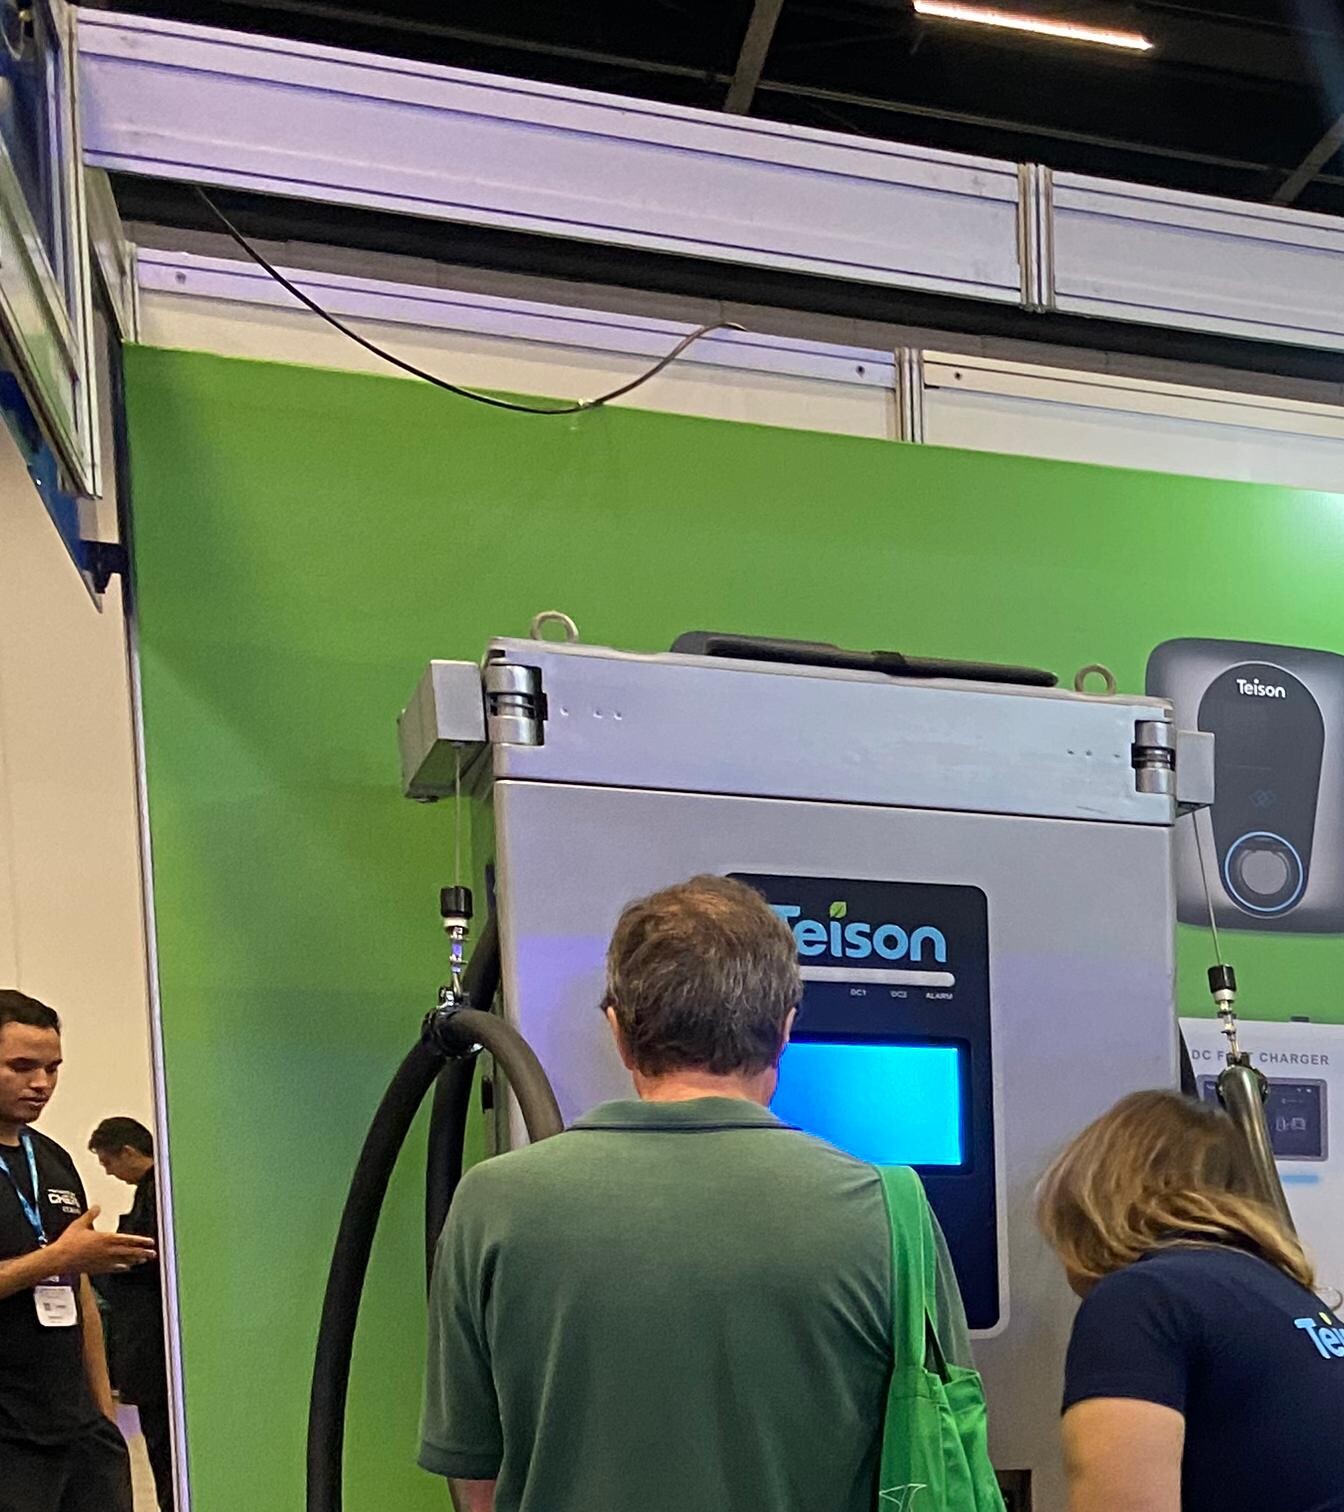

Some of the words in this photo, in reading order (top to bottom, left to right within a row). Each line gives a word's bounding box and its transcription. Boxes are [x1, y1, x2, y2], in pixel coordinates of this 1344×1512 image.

[1236, 678, 1286, 698] Teison
[925, 992, 953, 1001] ALARM
[1191, 1049, 1211, 1060] DC
[1259, 1052, 1329, 1066] CHARGER
